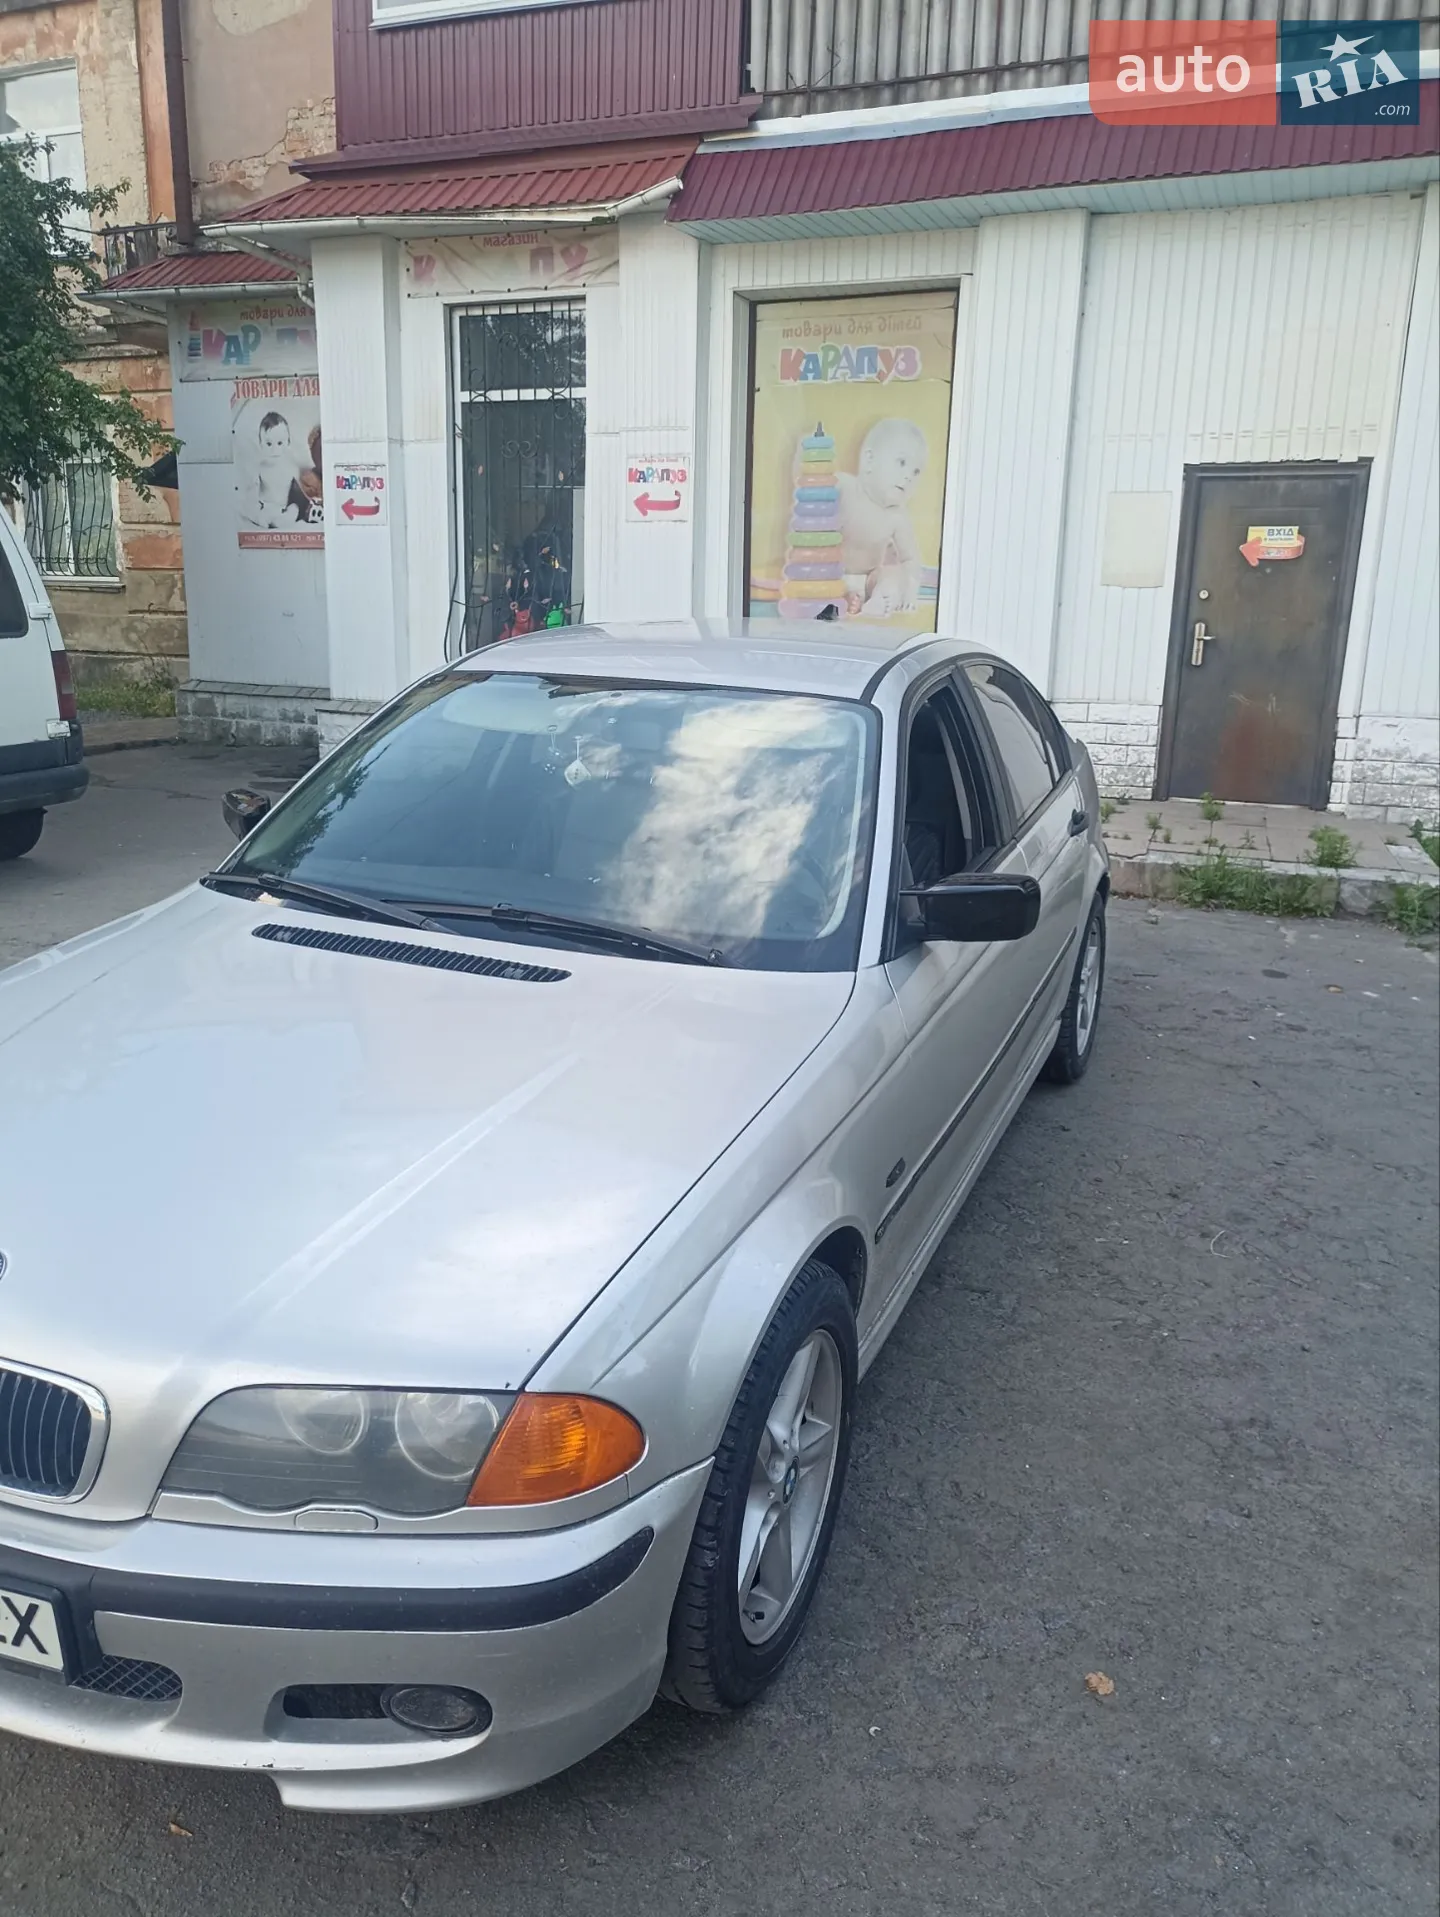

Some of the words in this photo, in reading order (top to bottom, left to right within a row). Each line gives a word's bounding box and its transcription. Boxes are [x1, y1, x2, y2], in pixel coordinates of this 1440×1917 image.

[241, 305, 284, 326] товари
[287, 303, 306, 318] для
[782, 320, 843, 343] товари
[780, 342, 920, 382] КАРАПУЗ
[233, 379, 288, 399] ТОВАРИ
[336, 474, 385, 491] КАРАПУЗ
[627, 466, 687, 484] КАРАПУЗ
[1267, 528, 1295, 537] ВХІД
[0, 1595, 49, 1655] X
